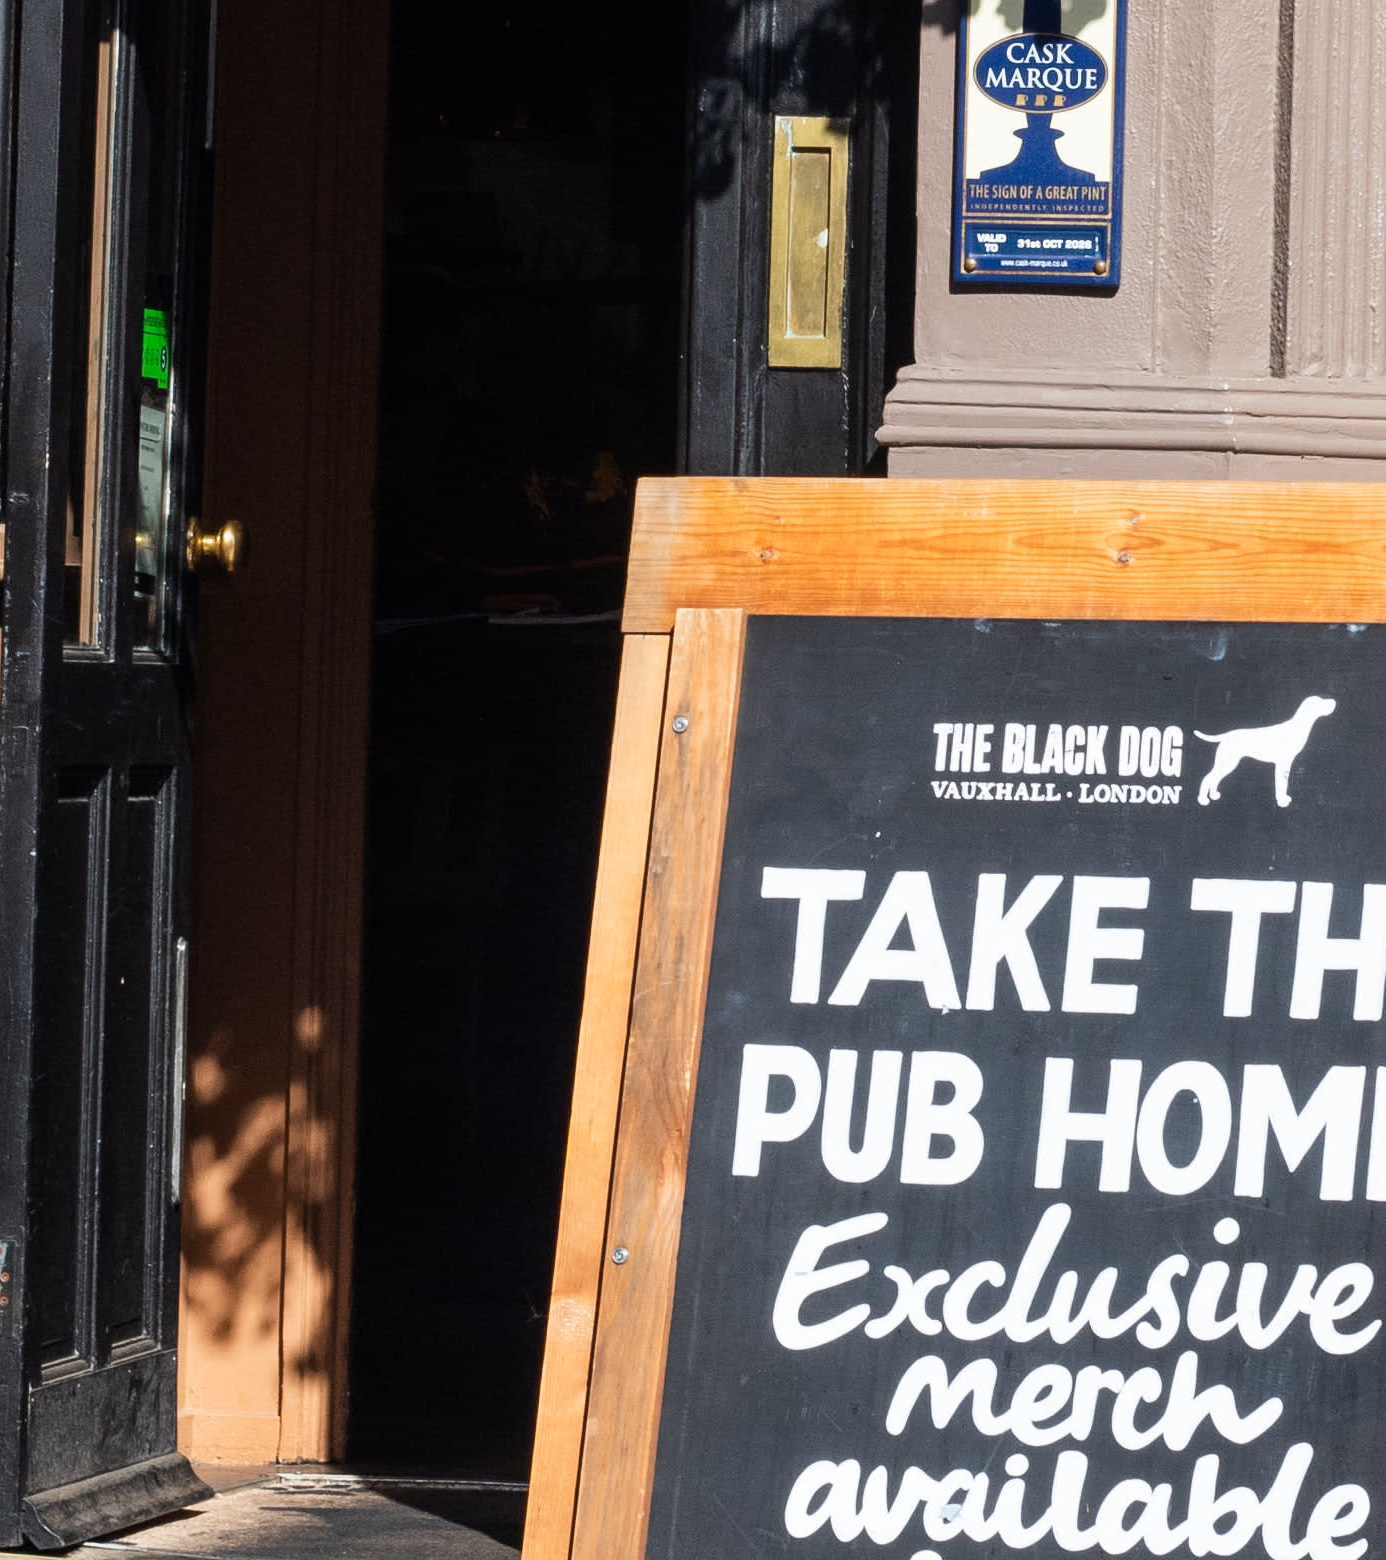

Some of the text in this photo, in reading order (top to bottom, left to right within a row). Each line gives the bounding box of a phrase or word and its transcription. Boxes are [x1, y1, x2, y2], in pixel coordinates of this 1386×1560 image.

[1006, 42, 1075, 66] CASK
[984, 66, 1098, 93] MARQUE
[969, 183, 1107, 201] THE SIGN OF A GREAT PINT
[970, 202, 1105, 212] INDEPENDENTLY INSPECTED
[976, 233, 1007, 243] VALID
[1016, 238, 1042, 249] 31st
[1042, 239, 1064, 249] OCT
[984, 243, 999, 253] TO
[932, 722, 1184, 778] THE BLACK DOG
[931, 780, 1183, 805] VAUXHALL LONDON
[760, 866, 1150, 1015] TAKE
[732, 1042, 985, 1186] PUB
[771, 1202, 1383, 1355] Exclusive
[885, 1350, 1284, 1452] merch
